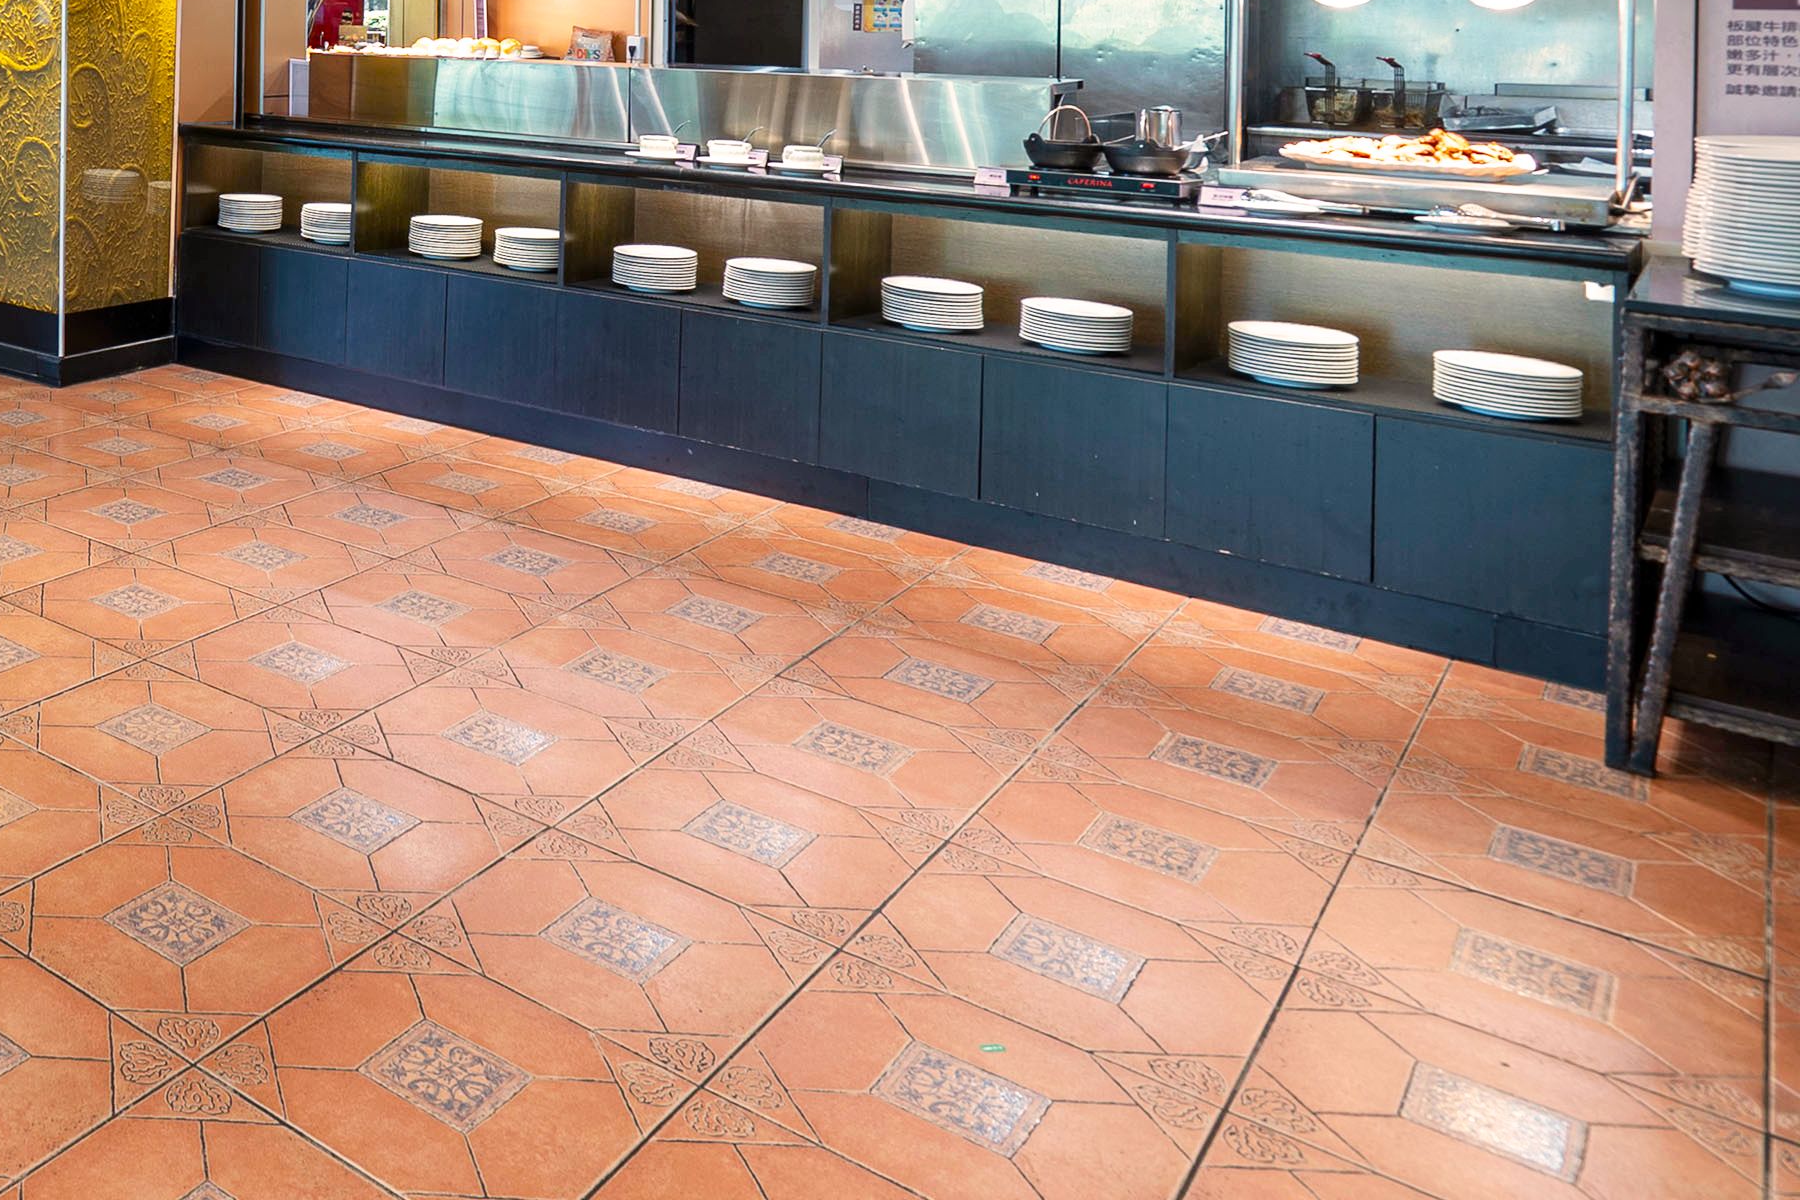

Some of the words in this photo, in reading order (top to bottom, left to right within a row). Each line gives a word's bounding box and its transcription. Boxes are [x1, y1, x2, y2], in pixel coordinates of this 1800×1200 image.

[1726, 63, 1800, 77] 更有層次
[1725, 83, 1800, 98] 誠摯邀請
